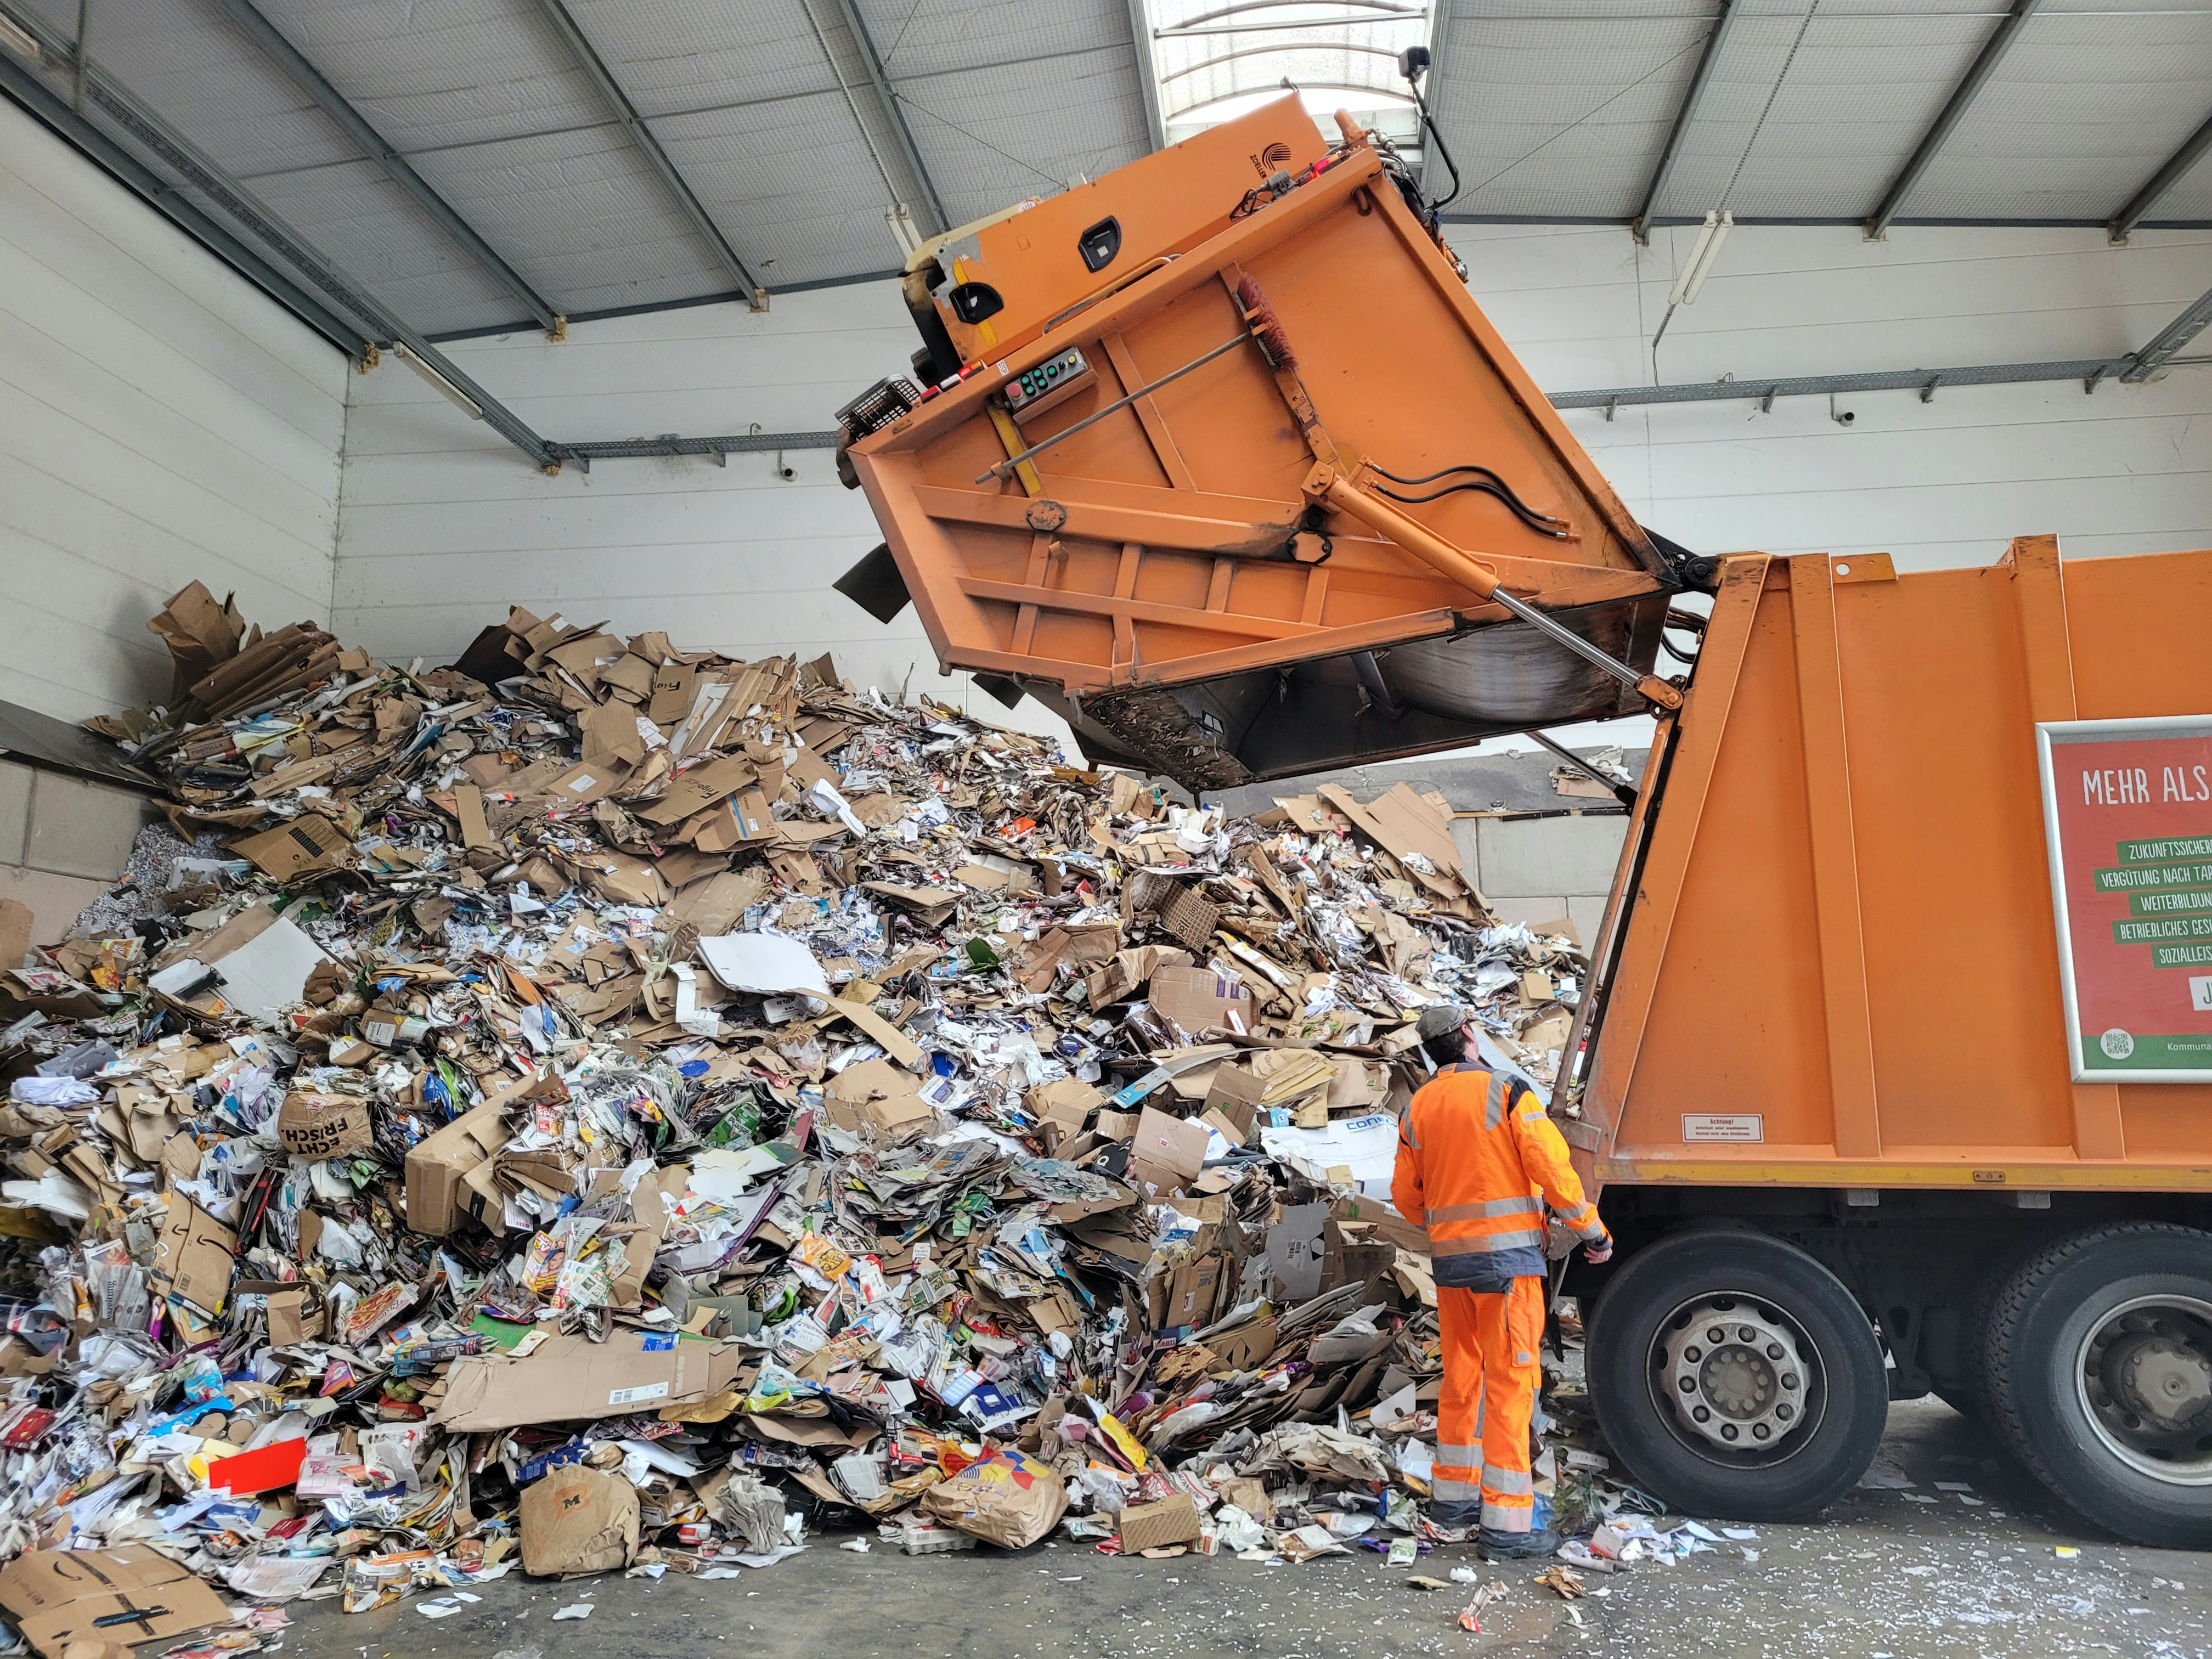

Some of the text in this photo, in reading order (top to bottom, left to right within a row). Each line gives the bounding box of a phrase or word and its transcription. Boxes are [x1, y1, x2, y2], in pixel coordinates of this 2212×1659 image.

[1250, 154, 1267, 179] ZOELLER
[998, 362, 1008, 374] STOP
[654, 681, 681, 691] Frig
[191, 743, 223, 755] TORTILLA
[2083, 765, 2210, 805] MEHR ALS
[2129, 839, 2212, 860] ZUKUNFTSSICHER
[2101, 870, 2160, 888] VERGÜTUNG
[2163, 867, 2191, 883] NACH
[2140, 893, 2212, 911] WEITERBILDUN
[1176, 923, 1188, 938] OBO
[2120, 920, 2189, 940] BETRIEBLICHES
[2159, 946, 2212, 964] SOZIALLEIS
[2203, 981, 2212, 1005] J
[297, 1136, 341, 1154] ECHT
[563, 1494, 581, 1510] M
